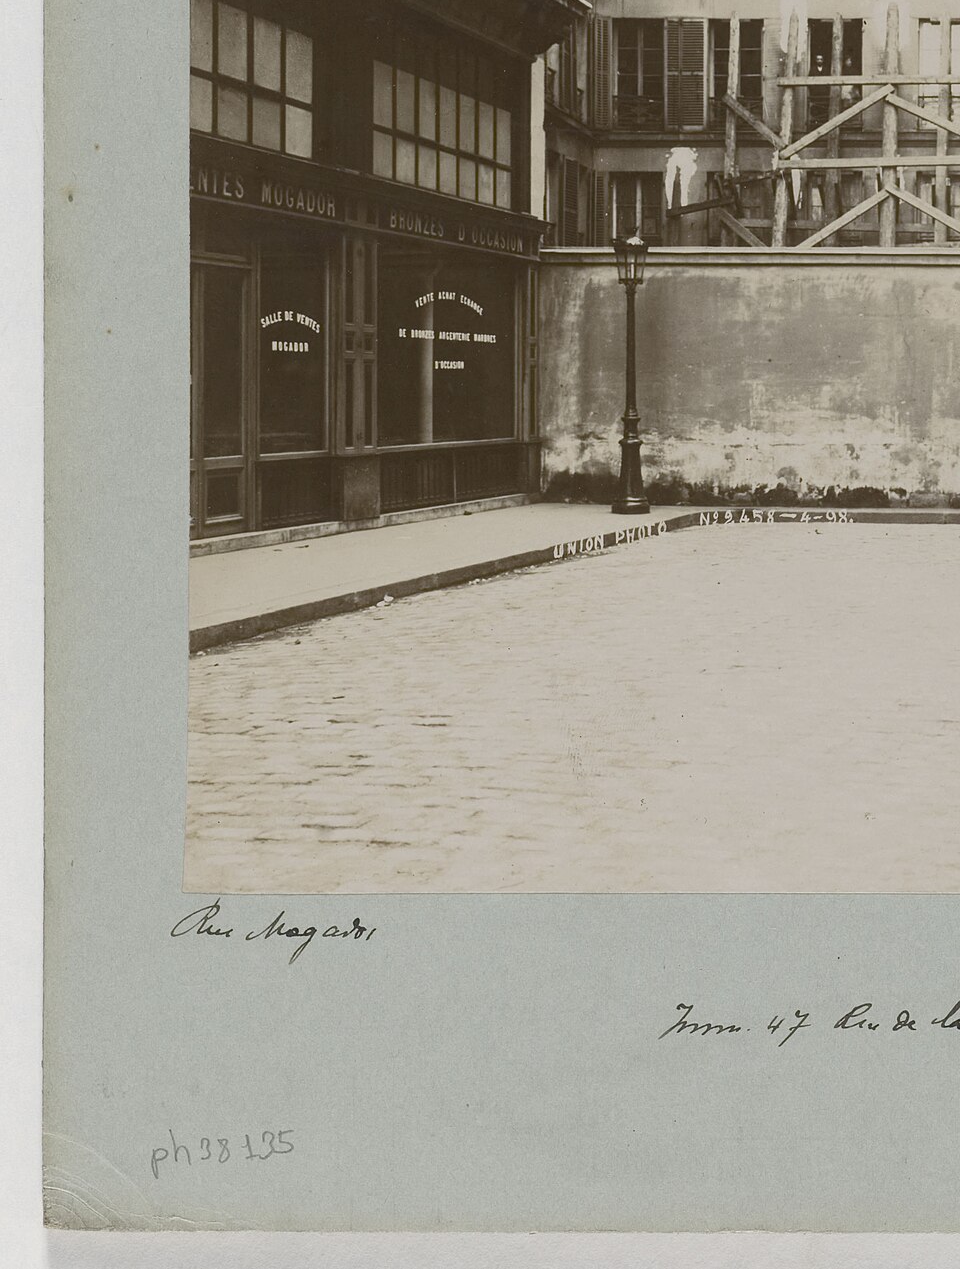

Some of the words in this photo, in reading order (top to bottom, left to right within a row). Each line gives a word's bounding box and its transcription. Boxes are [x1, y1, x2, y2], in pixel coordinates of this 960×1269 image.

[261, 180, 336, 218] MOGADOR
[389, 208, 445, 239] BRONZES
[414, 292, 435, 308] VENTE
[438, 291, 456, 300] ACHAT
[460, 294, 484, 316] ECHANGE
[260, 311, 283, 328] SALLE
[284, 310, 294, 321] DE
[296, 312, 321, 334] VENTES
[271, 340, 309, 352] MOGADOR
[398, 328, 407, 338] DE
[411, 329, 435, 340] BRONZES
[438, 331, 471, 342] ARGENTERIE
[473, 333, 497, 343] MARBRES
[434, 360, 465, 370] D'OCCASION
[170, 897, 235, 938] Rue
[767, 1009, 813, 1048] 47
[833, 1002, 881, 1031] Rue
[891, 1009, 917, 1032] de
